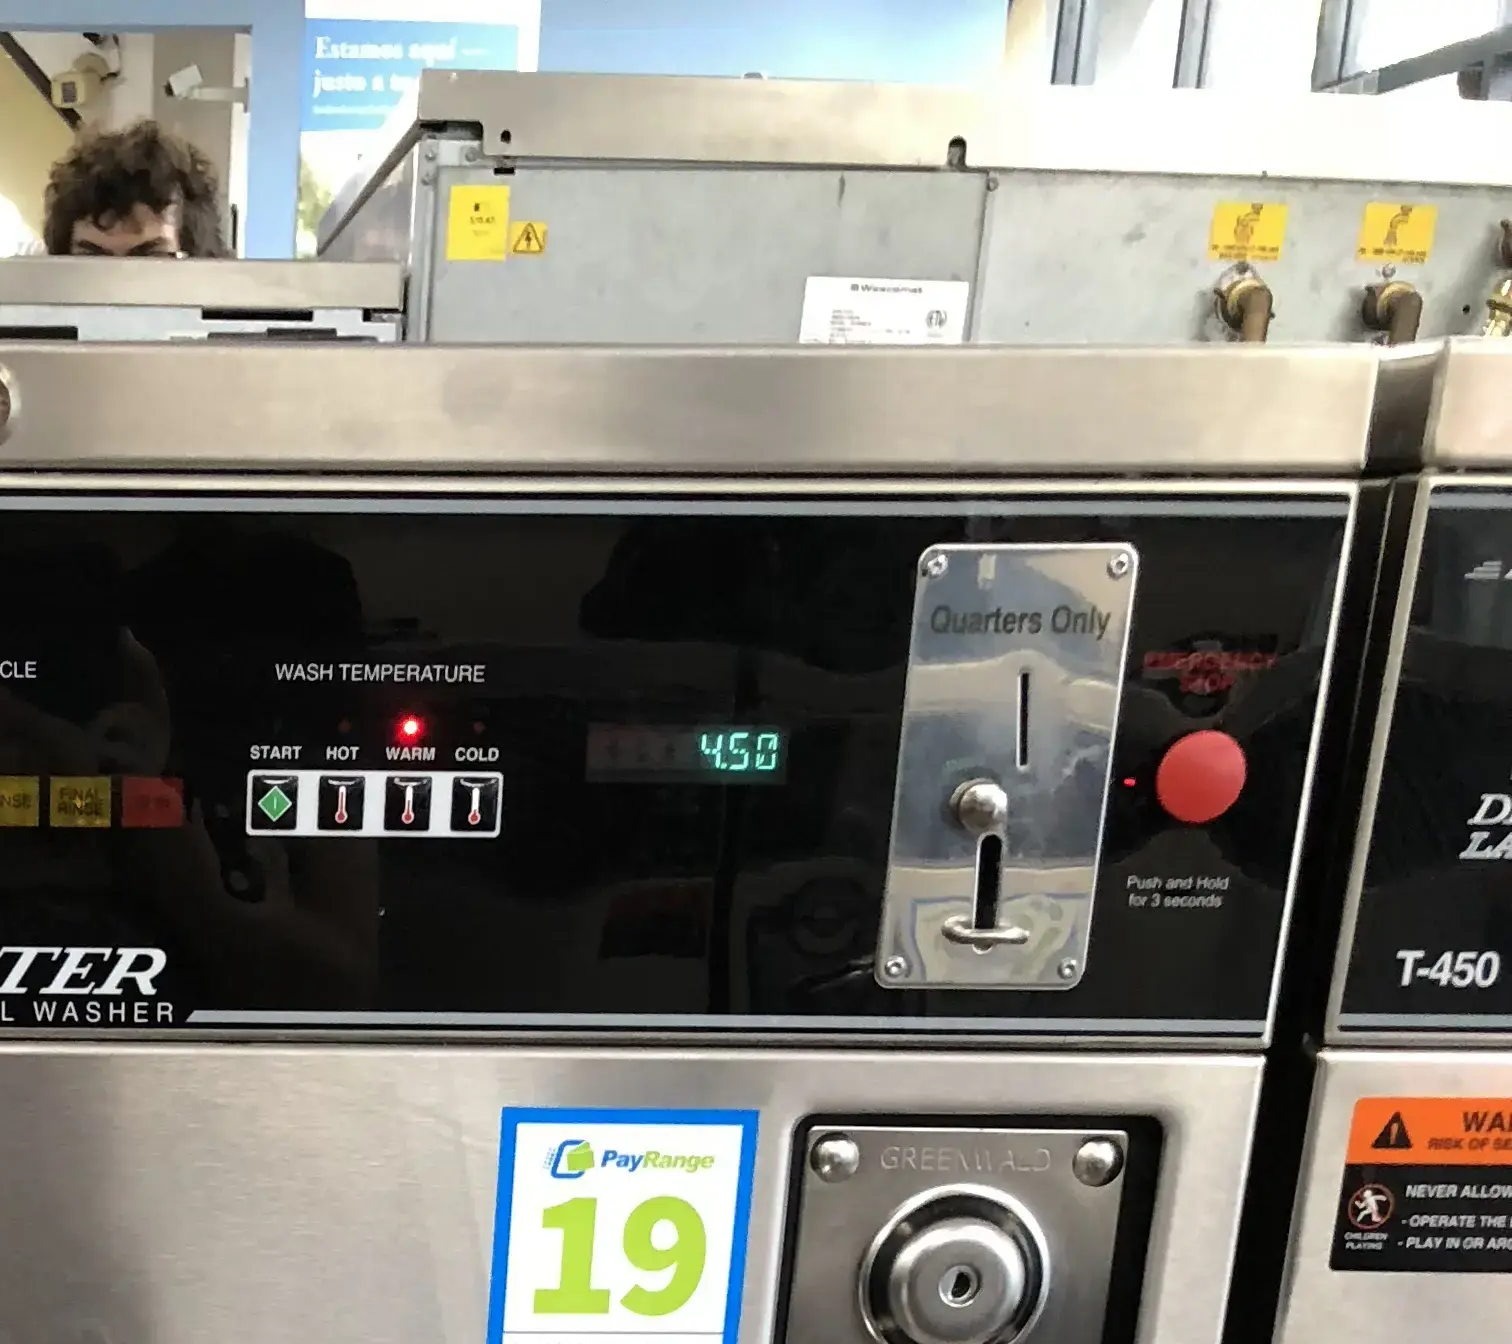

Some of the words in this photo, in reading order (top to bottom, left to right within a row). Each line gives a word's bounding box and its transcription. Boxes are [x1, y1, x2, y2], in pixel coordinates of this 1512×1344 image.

[930, 606, 1042, 634] Quarters
[1051, 606, 1111, 640] Only
[275, 664, 334, 682] WASH
[339, 664, 485, 683] TEMPERATURE
[250, 744, 302, 760] START
[326, 746, 358, 761] HOT
[386, 746, 435, 762] WARM
[455, 746, 499, 762] COLD
[700, 732, 778, 771] 4.50
[1127, 876, 1161, 889] Push
[1165, 876, 1193, 890] and
[1197, 877, 1229, 890] Hold
[1128, 893, 1148, 907] for
[1151, 894, 1160, 907] 3
[1164, 895, 1222, 908] seconds
[1396, 949, 1500, 988] T-450
[33, 1001, 174, 1023] WASHER
[601, 1149, 715, 1173] PayRange
[881, 1146, 1050, 1171] GREENWALD
[1406, 1185, 1457, 1198] NEVER
[532, 1195, 707, 1316] 19
